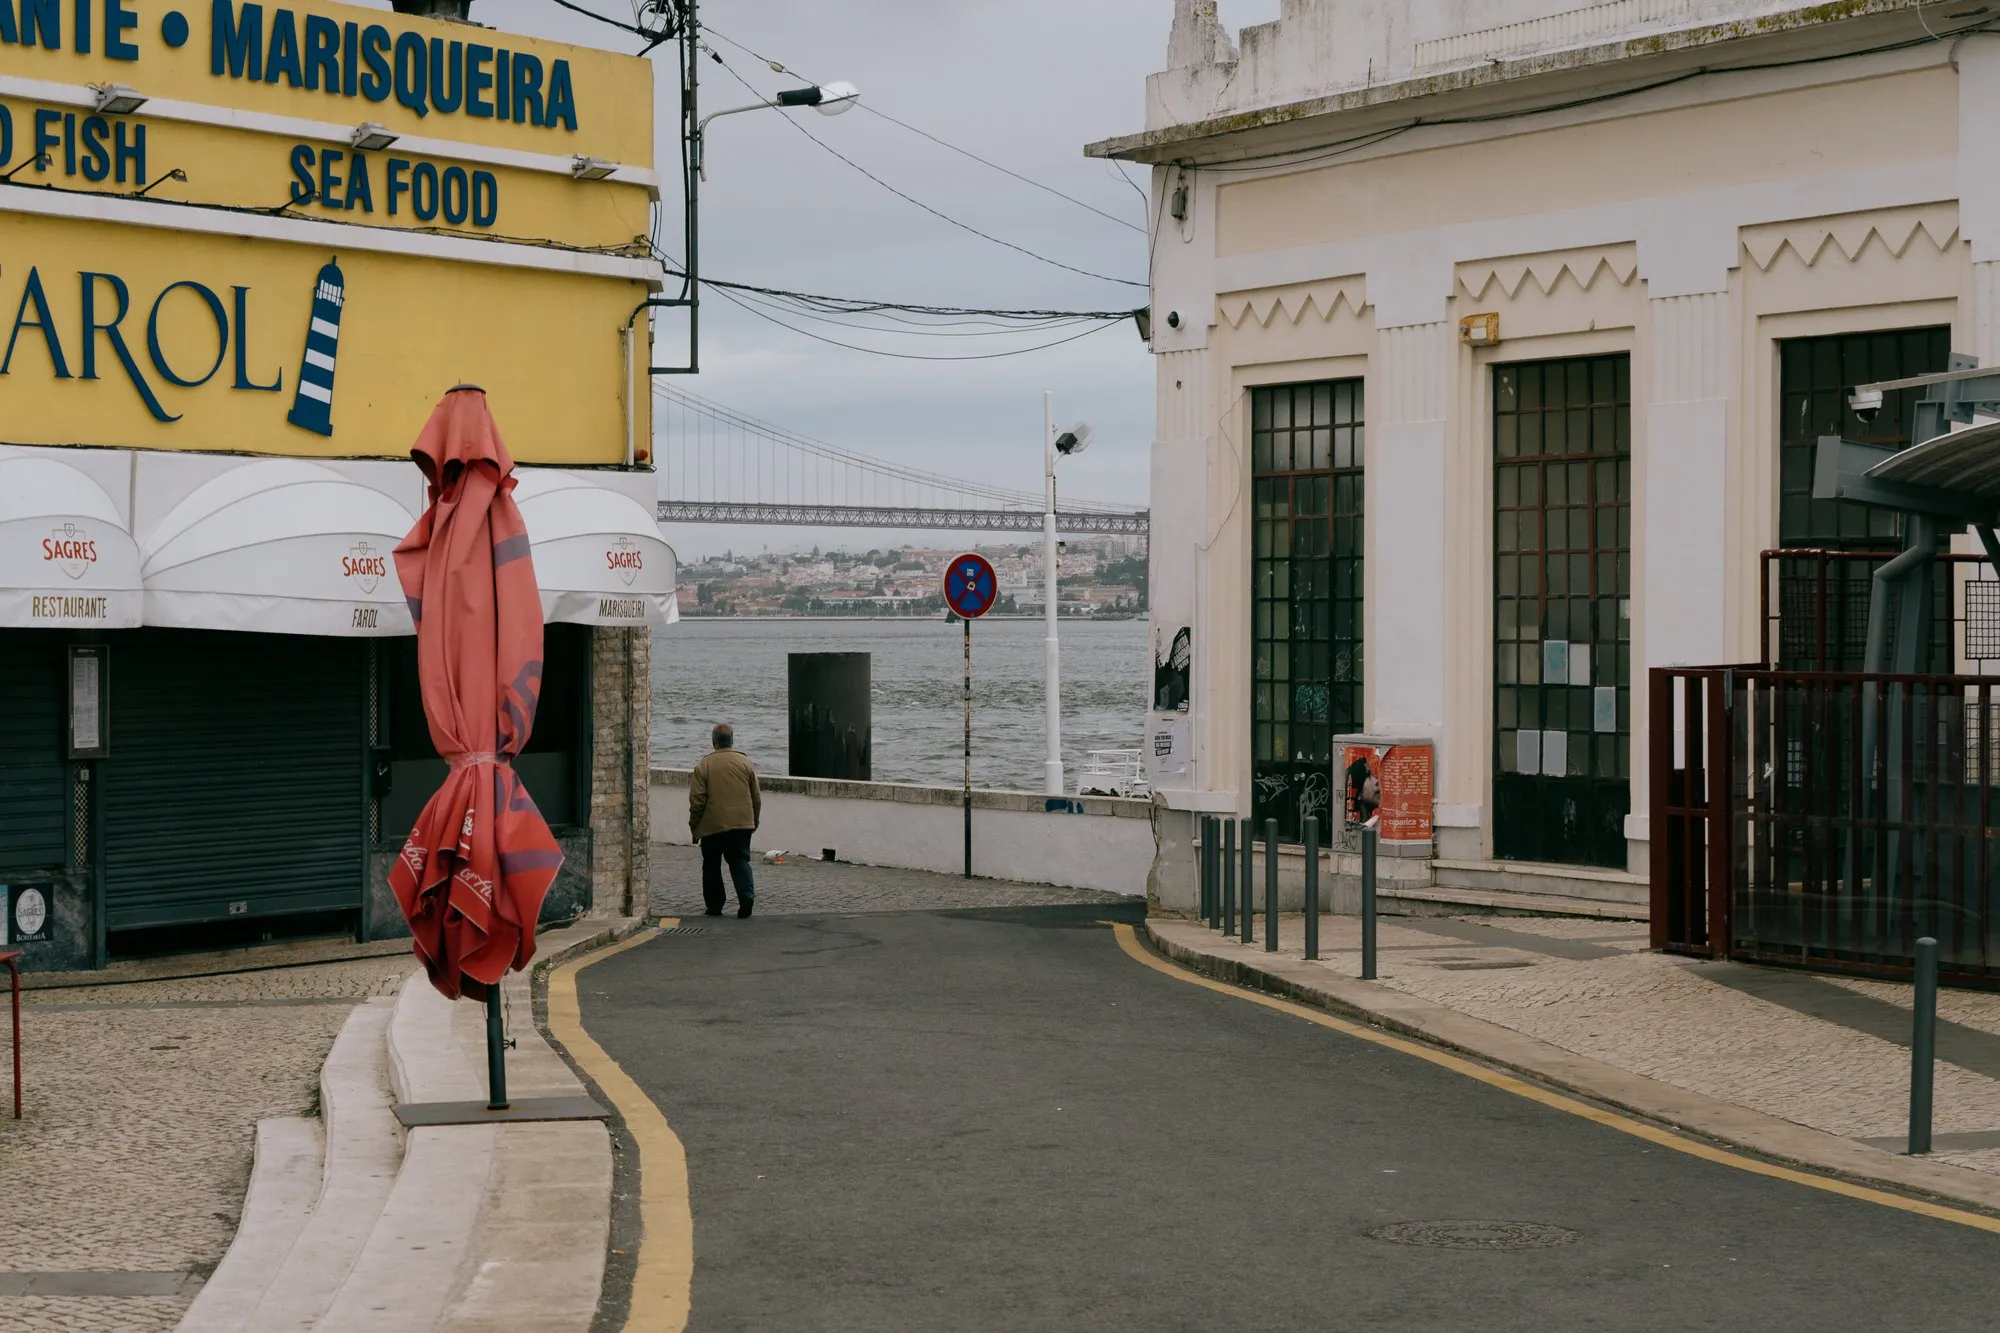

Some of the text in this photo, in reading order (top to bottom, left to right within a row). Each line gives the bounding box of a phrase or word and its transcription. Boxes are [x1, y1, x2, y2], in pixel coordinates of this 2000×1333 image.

[211, 0, 578, 131] MARISQUEIRA
[35, 108, 146, 185] FISH
[290, 144, 498, 227] SEA FOOD
[42, 538, 97, 563] SAGRES
[605, 551, 642, 570] SAGRES
[342, 556, 386, 577] SAGRES
[32, 596, 107, 618] RESTAURANTE
[352, 608, 378, 628] FAROL
[599, 599, 645, 618] MARISQUEIRA
